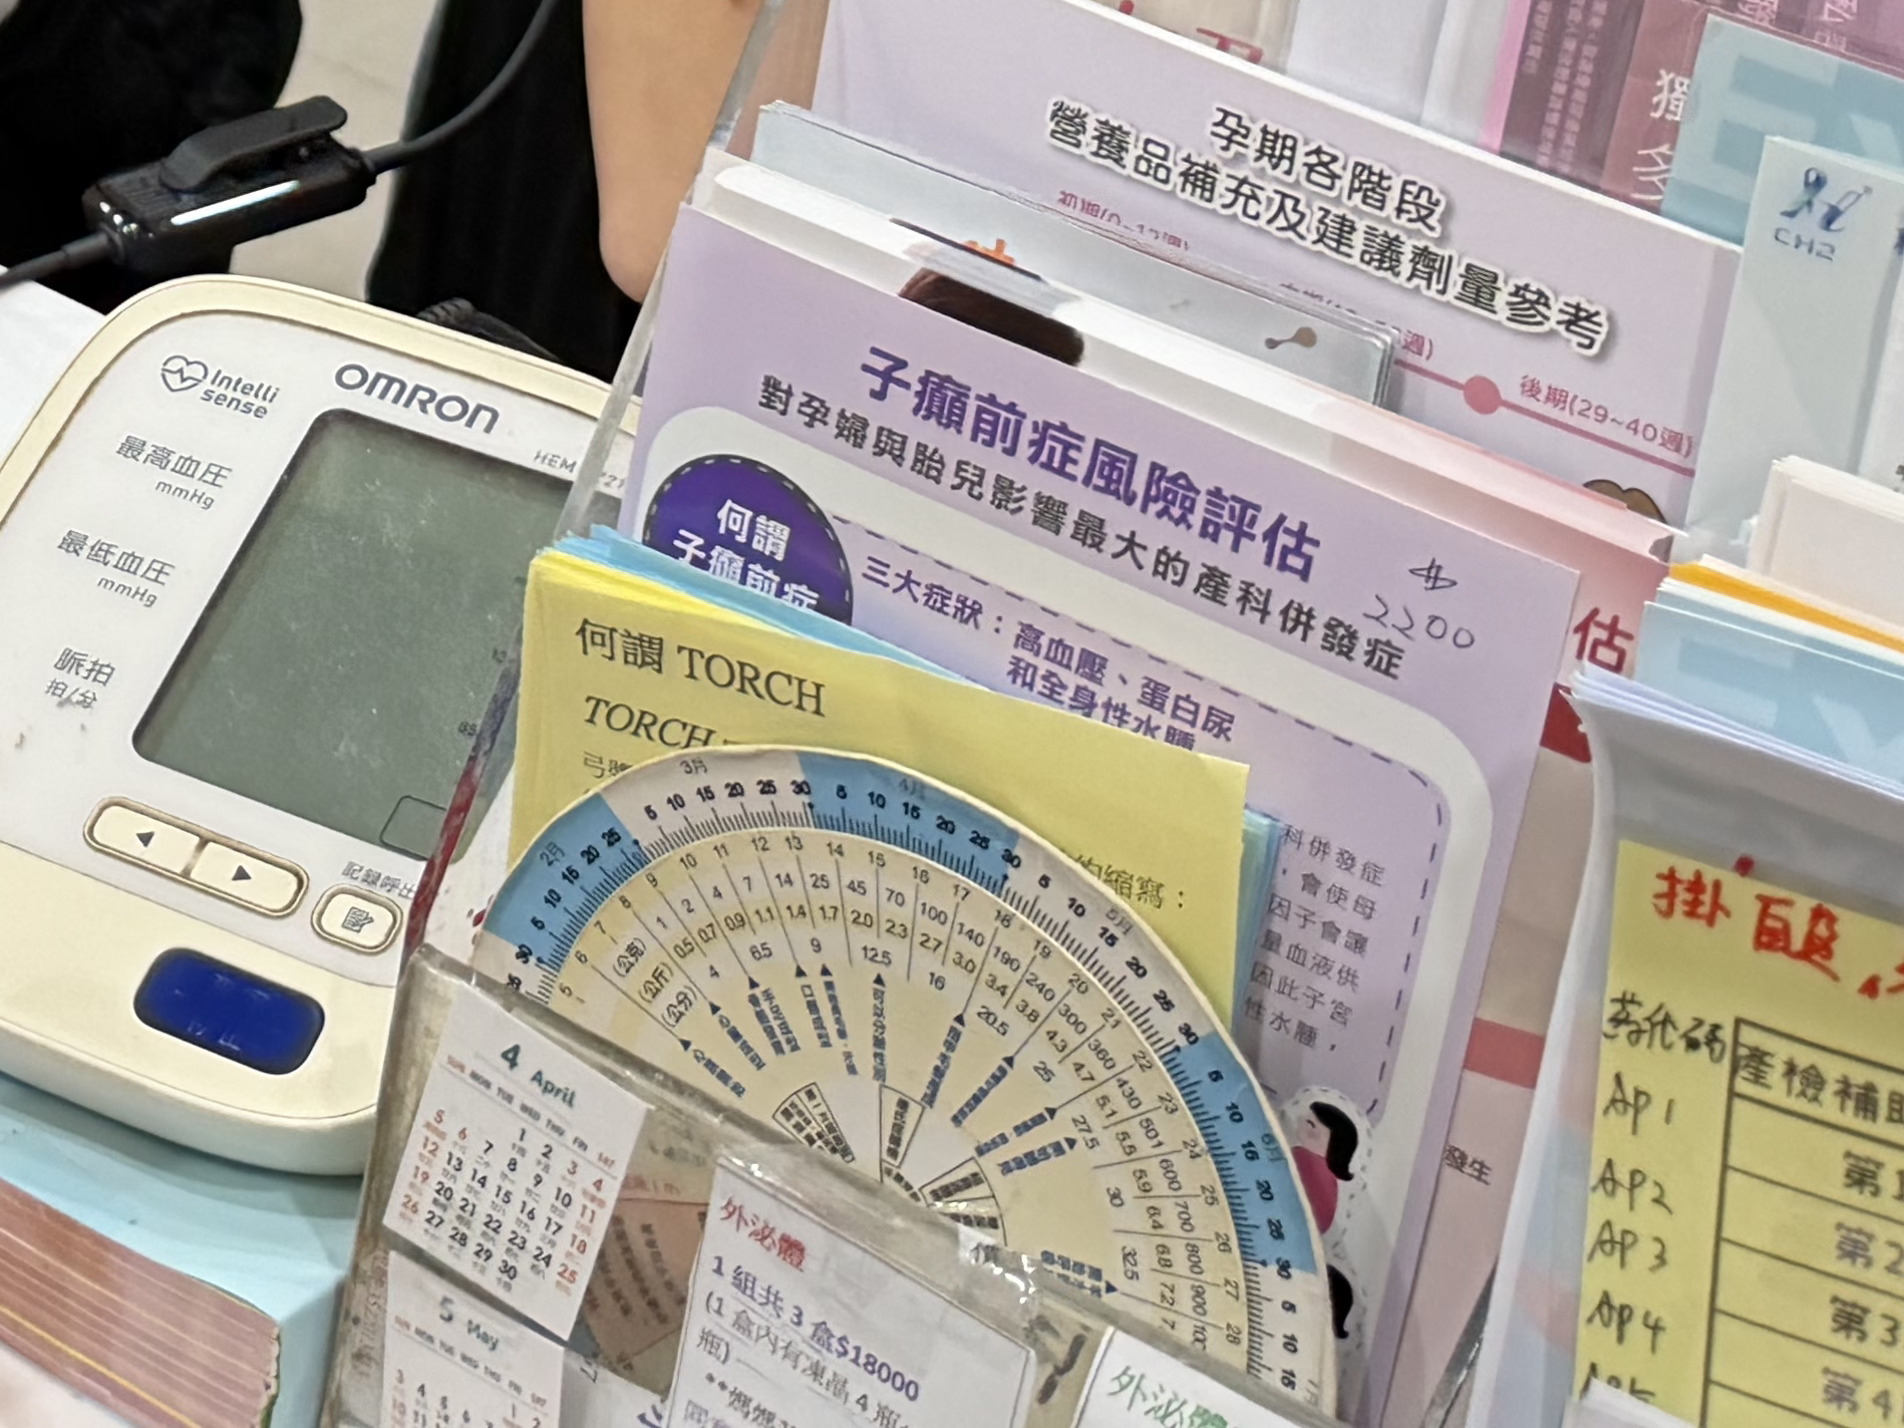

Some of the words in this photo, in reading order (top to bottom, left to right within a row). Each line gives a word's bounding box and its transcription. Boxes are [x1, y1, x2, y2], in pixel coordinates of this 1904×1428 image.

[1210, 106, 1444, 233] 孕期各階段
[1048, 99, 1608, 352] 營養品補充及建議劑量參考
[200, 387, 269, 420] sense
[209, 368, 280, 404] Intelli
[335, 363, 499, 434] OMRON
[861, 346, 1320, 582] 子癲前症風險評估
[155, 480, 215, 511] mmHg
[716, 499, 792, 561] 何謂
[758, 374, 1405, 680] 對孕婦與胎兒影響最大的產科併發症
[97, 575, 158, 608] mmHg
[1363, 595, 1476, 649] 2200
[575, 618, 663, 675] 何謂
[676, 645, 826, 717] TORCH
[1573, 608, 1634, 678] 估
[583, 695, 716, 749] TORCH
[666, 793, 686, 812] 10
[868, 791, 887, 810] 10
[1281, 824, 1385, 887] 科併發症
[500, 1044, 521, 1071] 4
[530, 1070, 576, 1108] April
[731, 1265, 784, 1318] 組共
[791, 1305, 804, 1327] 3
